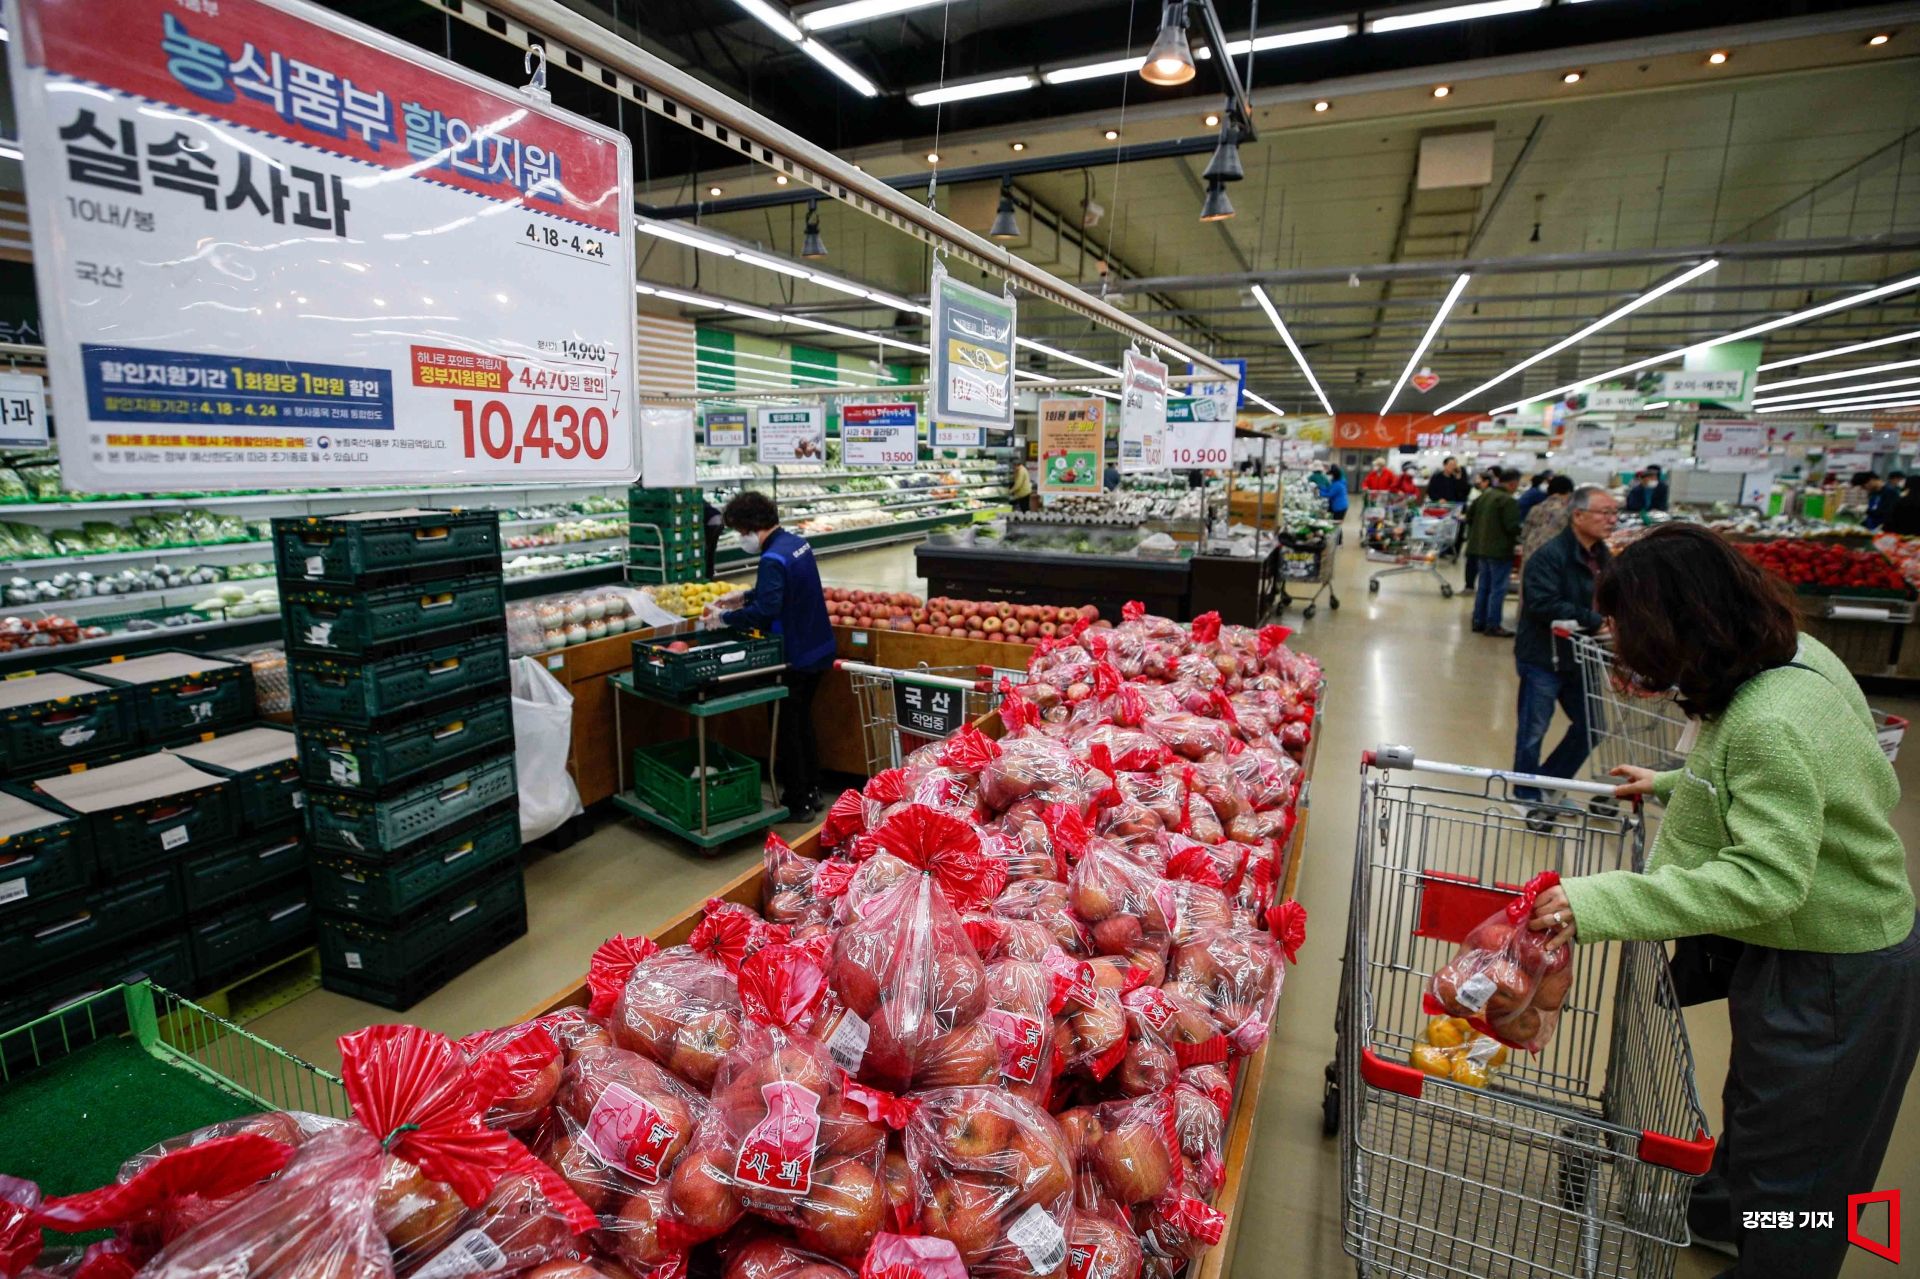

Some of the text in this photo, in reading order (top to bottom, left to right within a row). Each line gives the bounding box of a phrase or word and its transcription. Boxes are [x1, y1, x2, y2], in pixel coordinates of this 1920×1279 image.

[161, 12, 557, 197] 농식품부 할인지원
[59, 108, 351, 237] 실속사과
[75, 260, 124, 289] 국산
[417, 352, 502, 371] 하나로 포인트 적립시
[561, 340, 606, 362] 14,900
[101, 360, 380, 397] 할인지원기간 1회원당 1만원 할인
[420, 365, 502, 389] 정부지원할인
[583, 376, 605, 394] 할인
[454, 399, 609, 464] 10,430
[1172, 449, 1227, 465] 10,900
[912, 713, 945, 731] 작업중
[746, 1152, 803, 1187] 사과
